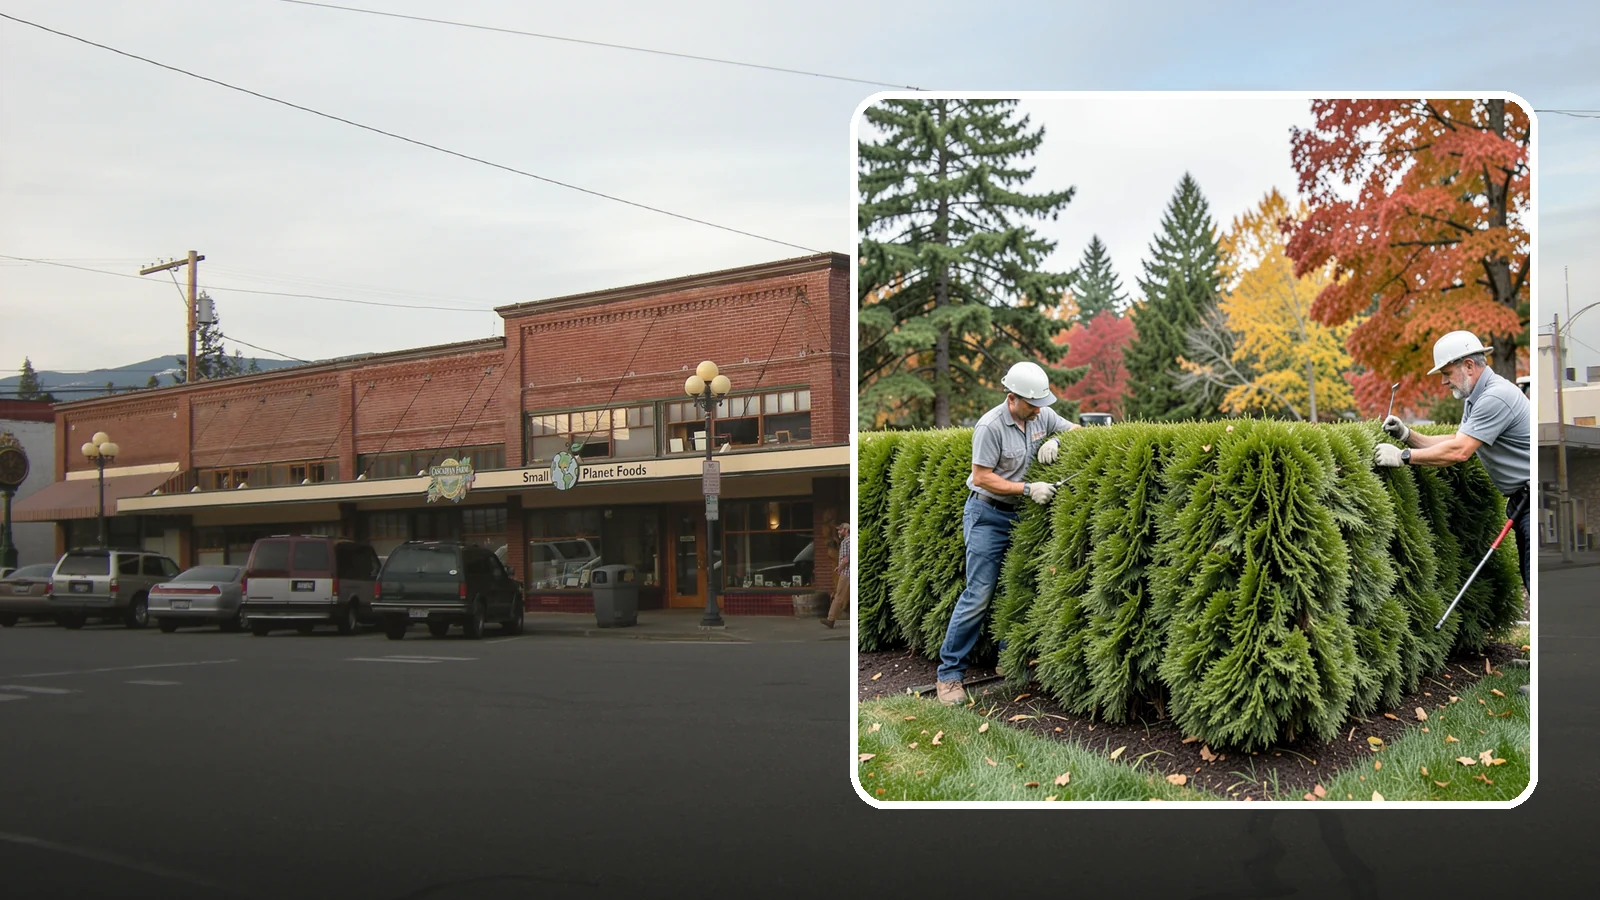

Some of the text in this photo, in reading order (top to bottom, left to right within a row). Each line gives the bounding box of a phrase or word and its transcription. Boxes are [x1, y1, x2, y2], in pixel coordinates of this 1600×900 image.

[523, 464, 646, 482] Small Planet Foods
